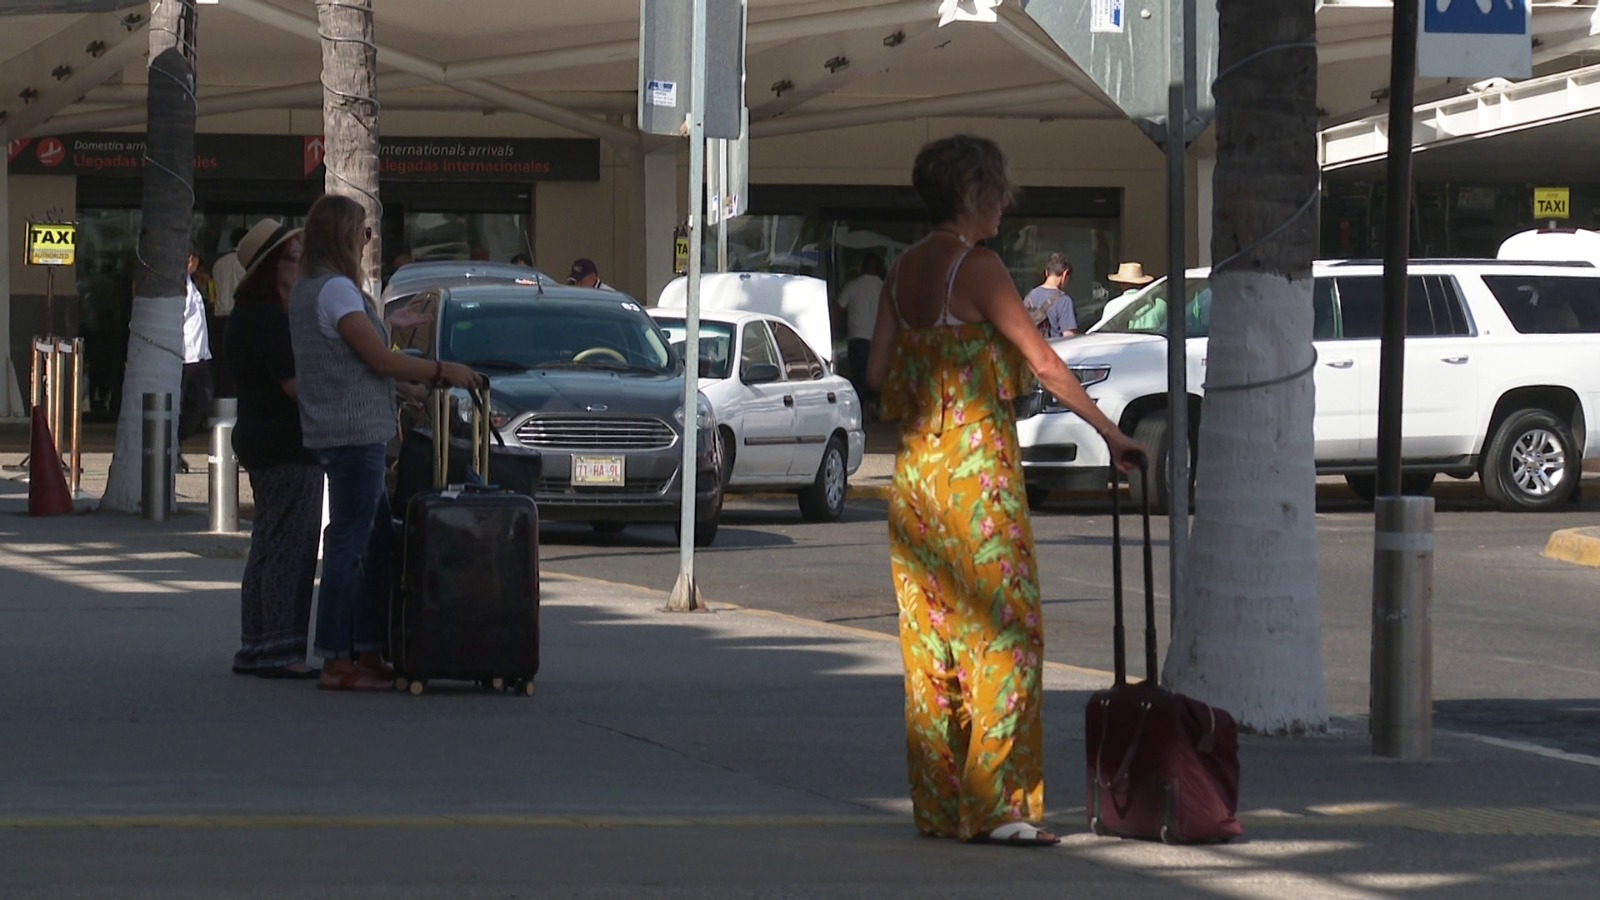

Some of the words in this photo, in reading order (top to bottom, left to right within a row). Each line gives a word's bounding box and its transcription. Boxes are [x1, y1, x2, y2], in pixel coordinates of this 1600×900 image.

[74, 140, 124, 151] Domestics
[126, 141, 144, 151] arri
[377, 143, 466, 157] Internationals
[469, 144, 515, 157] arrivals
[73, 154, 137, 170] Llegadas
[443, 159, 551, 174] Internacionales
[1537, 200, 1566, 213] TAXI
[31, 229, 76, 245] TAXI
[677, 243, 688, 255] TA
